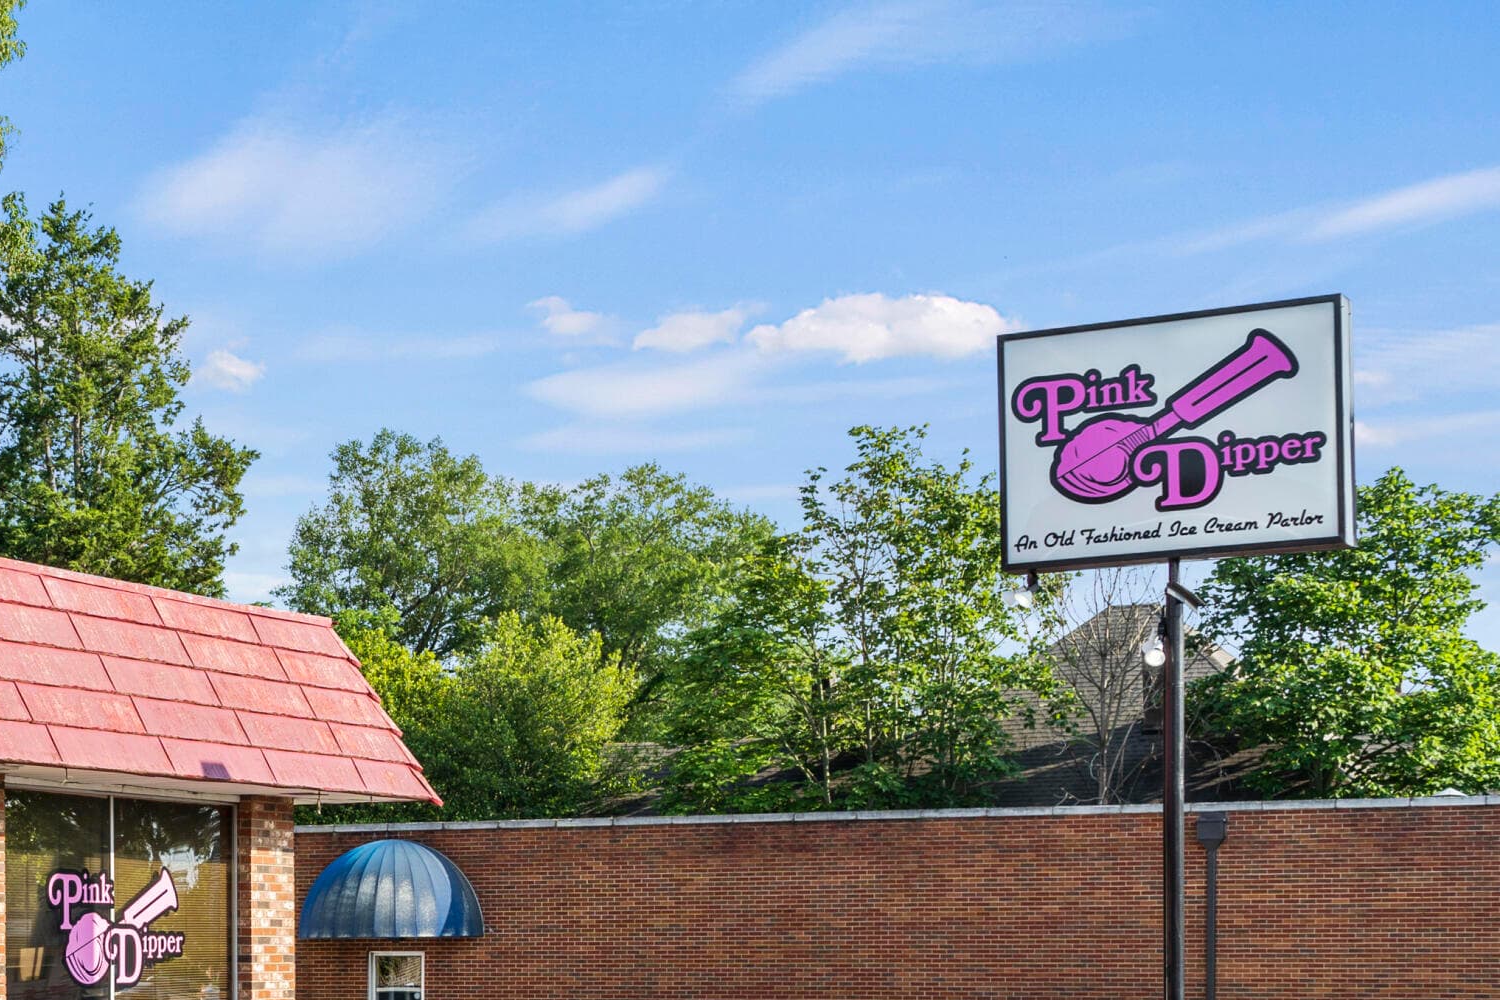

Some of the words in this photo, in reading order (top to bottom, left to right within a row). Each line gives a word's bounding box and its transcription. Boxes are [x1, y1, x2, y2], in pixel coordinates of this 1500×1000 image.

[1016, 370, 1152, 442] Pink
[1133, 434, 1321, 507] Dipper
[1014, 535, 1038, 552] An
[1044, 530, 1075, 548] Old
[1080, 522, 1161, 546] Fashioned
[1167, 521, 1197, 537] Ice
[1203, 517, 1259, 534] Cream
[1266, 509, 1324, 530] Parlor
[48, 872, 114, 930] Pink
[104, 926, 183, 984] Dipper
